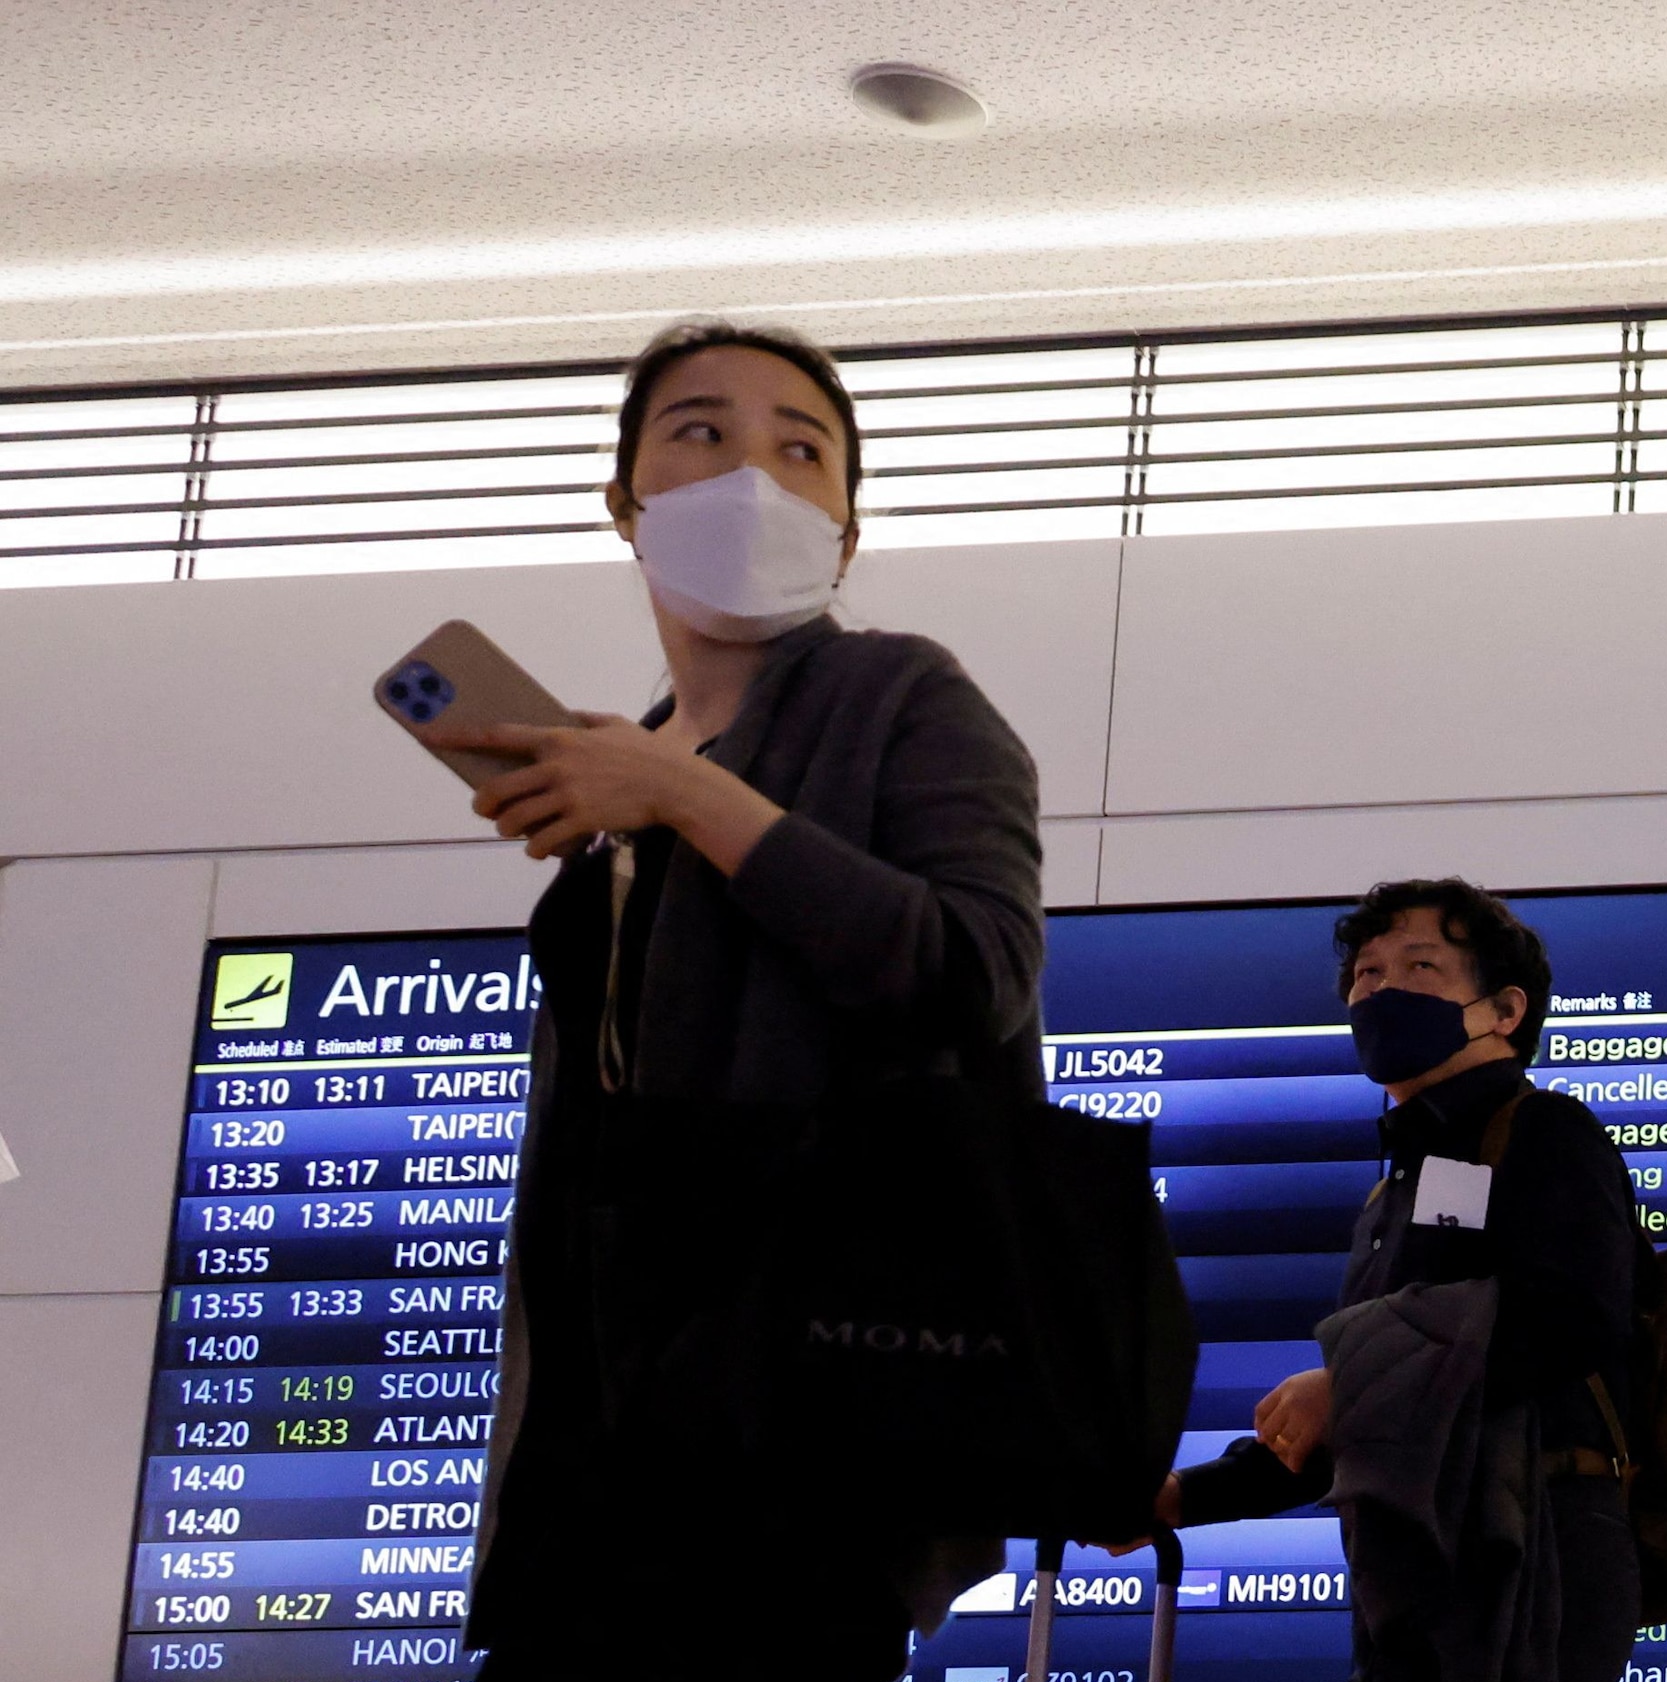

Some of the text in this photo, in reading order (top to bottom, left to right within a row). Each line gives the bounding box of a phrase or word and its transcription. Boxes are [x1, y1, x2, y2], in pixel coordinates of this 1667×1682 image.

[1551, 993, 1617, 1012] Remarks
[1623, 992, 1651, 1009] 备注
[219, 1041, 278, 1058] Scheduled
[317, 1037, 376, 1055] Estimated
[417, 1035, 463, 1051] Origin
[469, 1032, 512, 1049] 起飞地
[1060, 1049, 1163, 1077] JL5042
[217, 1079, 289, 1105] 13:10
[315, 1076, 384, 1102] 13:11
[212, 1121, 284, 1147] 13:20
[208, 1163, 279, 1189] 13:35
[306, 1160, 379, 1186] 13:17
[203, 1205, 274, 1231] 13:40
[302, 1202, 373, 1228] 13:25
[198, 1248, 269, 1273] 13:55
[396, 1240, 488, 1267] HONG
[192, 1293, 263, 1318] 13:55
[291, 1290, 362, 1315] 13:33
[389, 1287, 451, 1313] SAN
[187, 1335, 258, 1361] 14:00
[183, 1379, 253, 1404] 14:15
[282, 1376, 353, 1401] 14:19
[178, 1421, 249, 1447] 14:20
[277, 1419, 348, 1444] 14:33
[172, 1465, 244, 1491] 14:40
[372, 1459, 483, 1486] LOS AN
[167, 1508, 239, 1534] 14:40
[161, 1552, 235, 1578] 14:55
[1229, 1573, 1344, 1602] MH9101
[156, 1596, 229, 1623] 15:00
[257, 1594, 331, 1620] 14:27
[356, 1592, 420, 1618] SAN
[152, 1644, 223, 1669] 15:05
[353, 1639, 455, 1665] HANOI
